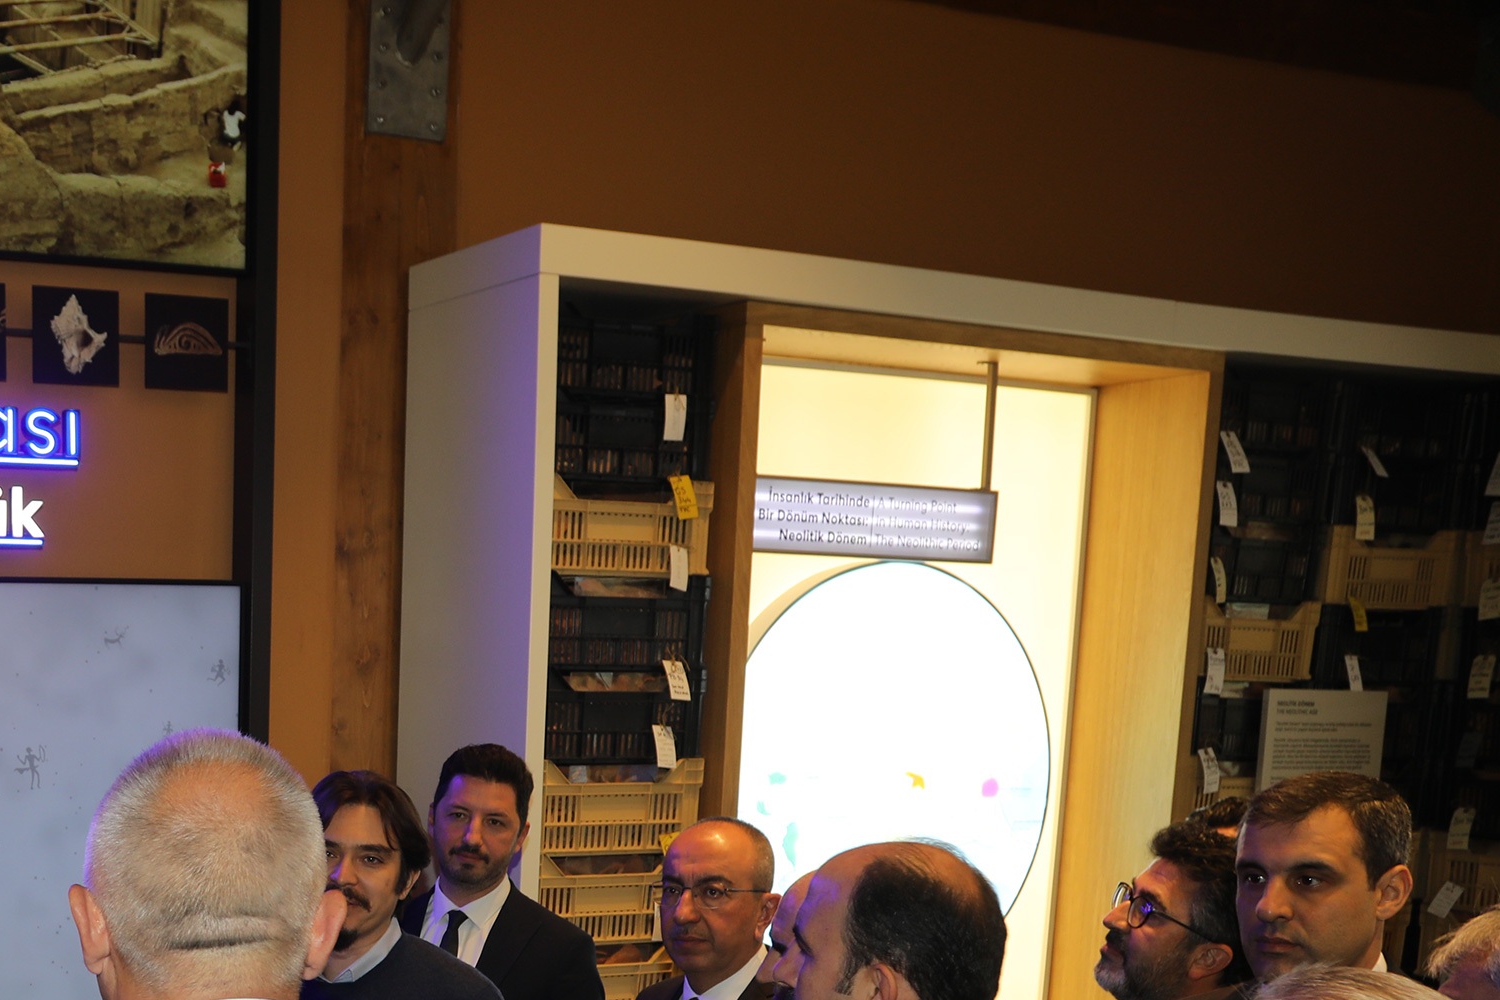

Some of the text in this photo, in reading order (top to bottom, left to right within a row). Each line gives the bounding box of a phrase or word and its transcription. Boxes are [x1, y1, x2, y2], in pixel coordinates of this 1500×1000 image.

[769, 486, 870, 508] İnsanlık Tarihinde
[877, 496, 957, 515] A Turning Point
[758, 508, 775, 521] Bir
[777, 509, 818, 524] Dönüm
[876, 515, 886, 528] in
[890, 516, 928, 530] Human
[779, 528, 867, 545] Neolitik Dönem
[875, 533, 980, 552] The Neolithic Period
